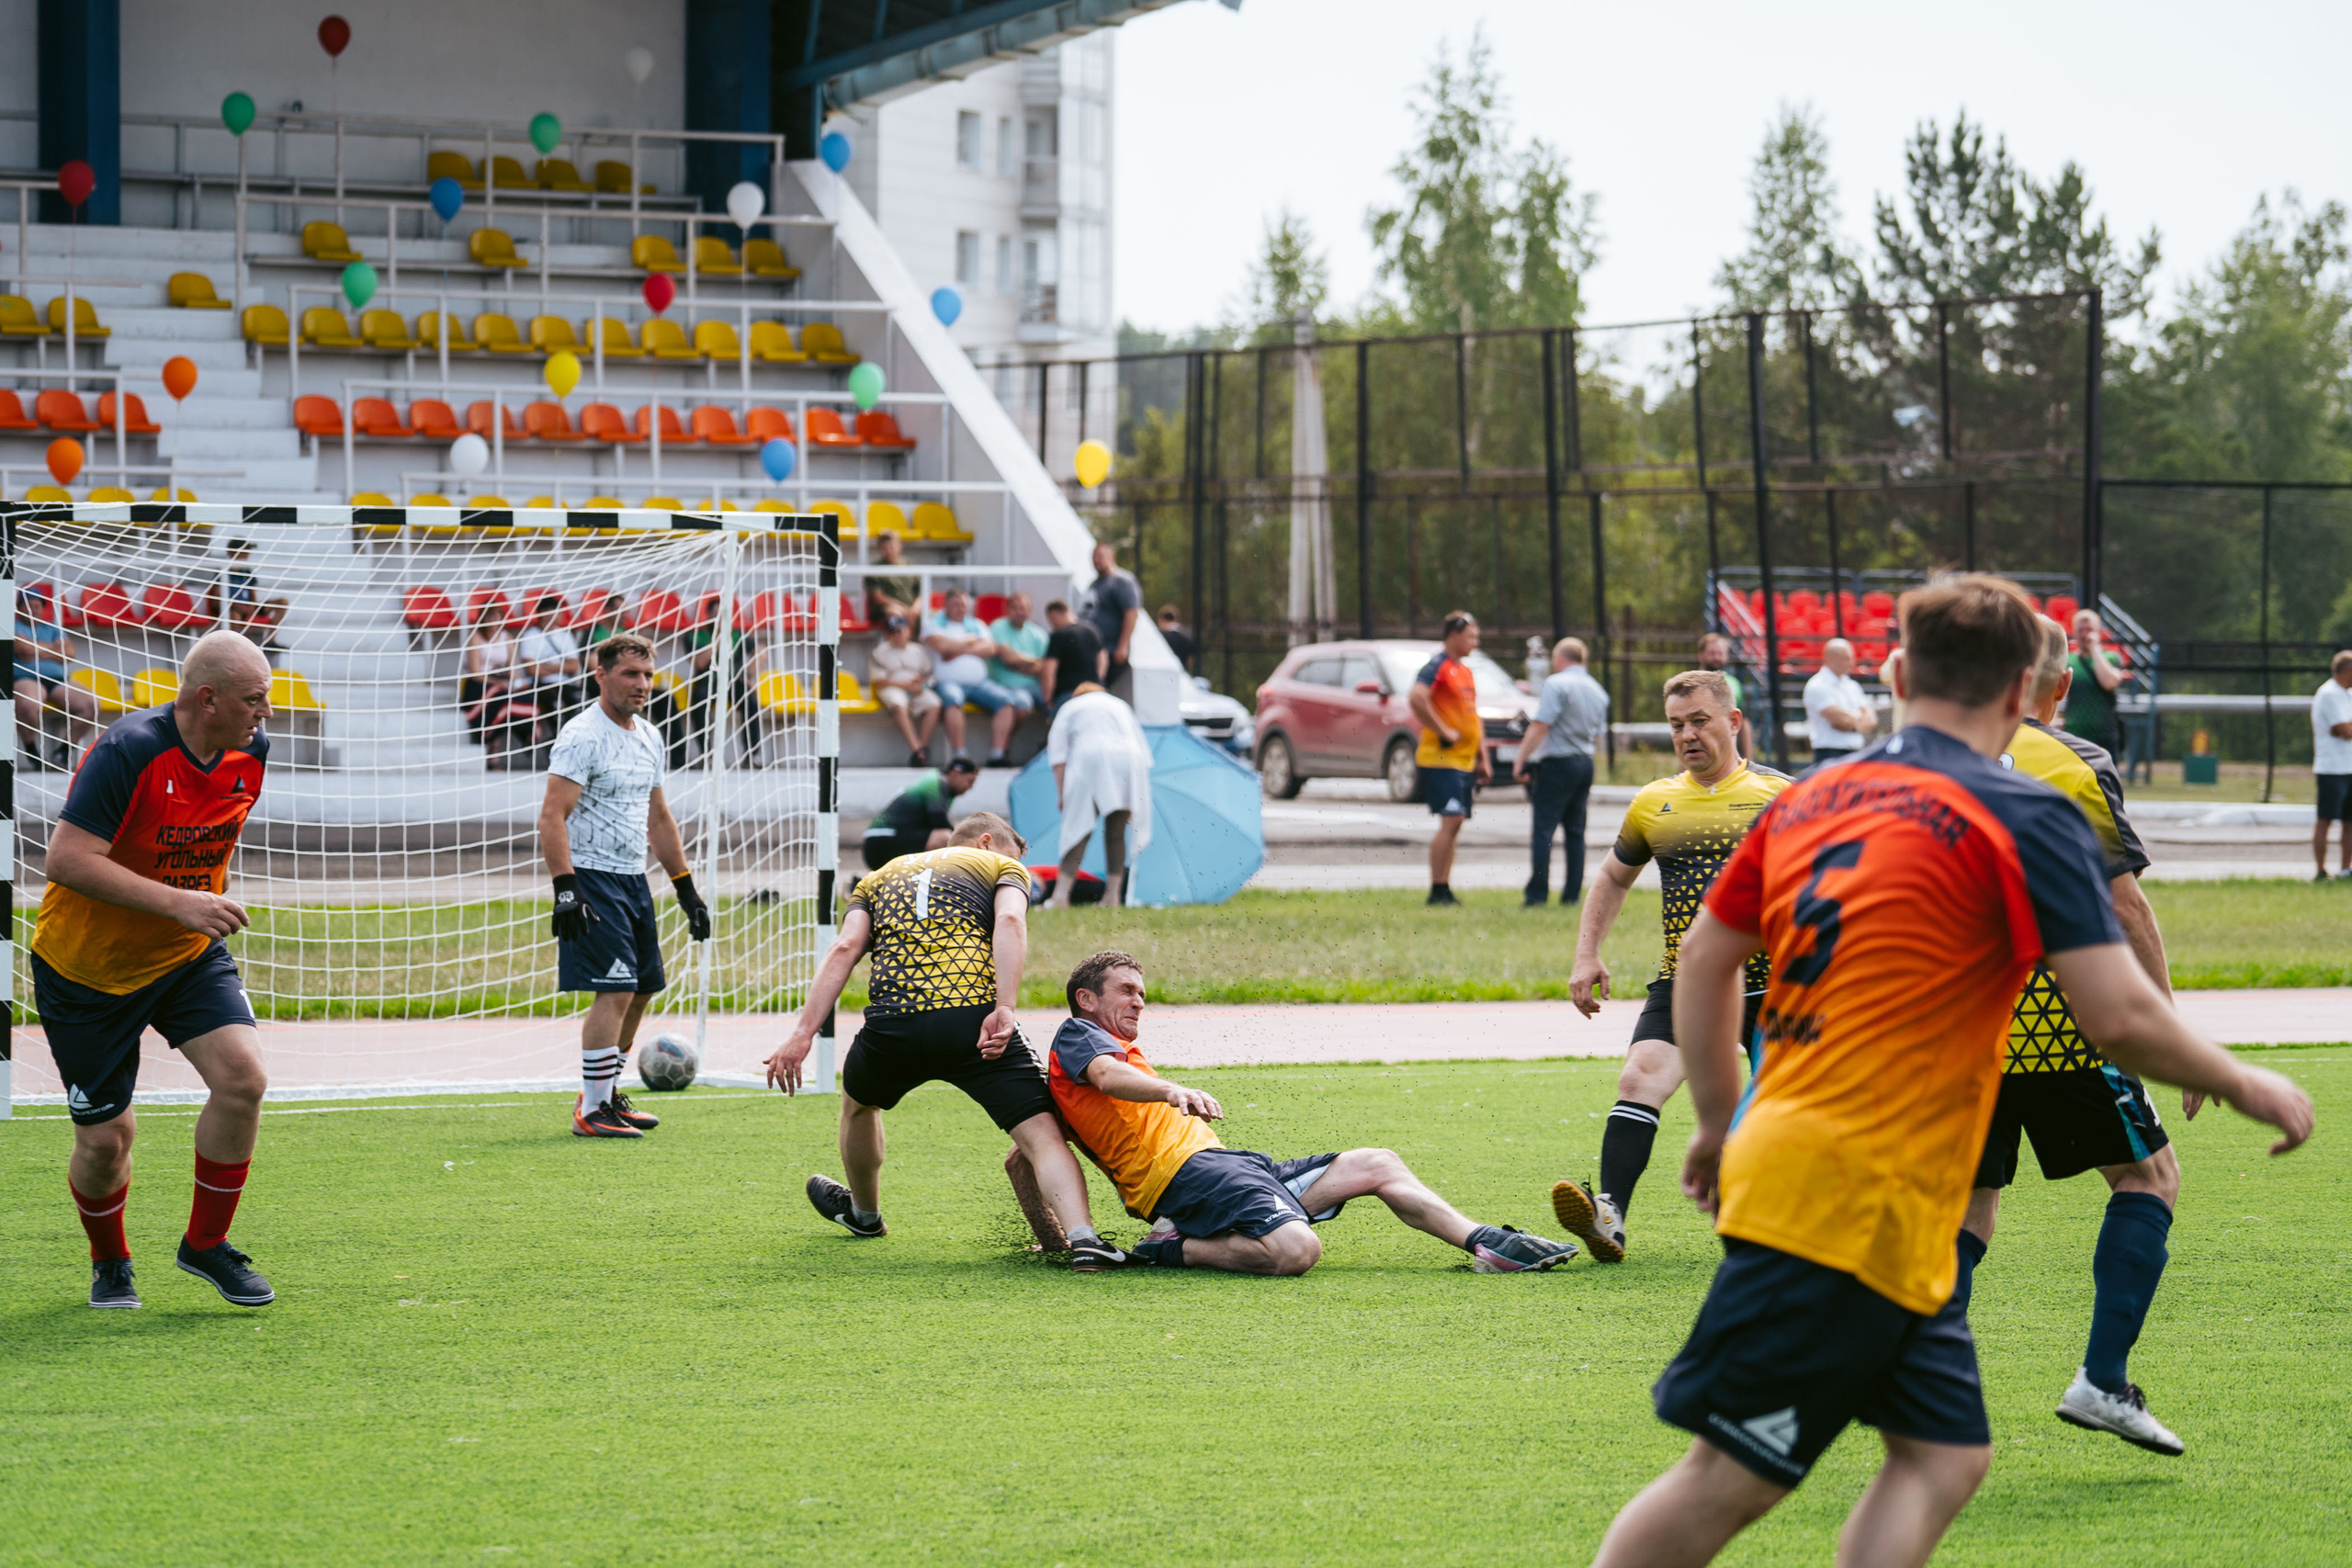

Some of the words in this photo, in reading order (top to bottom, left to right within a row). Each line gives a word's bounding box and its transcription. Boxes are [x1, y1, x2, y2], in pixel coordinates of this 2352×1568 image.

[155, 817, 240, 849] КЕДРОВСКИЙ
[154, 843, 229, 869] УГОЛЬНЫЙ
[910, 867, 933, 920] 1
[1780, 839, 1865, 987] 5
